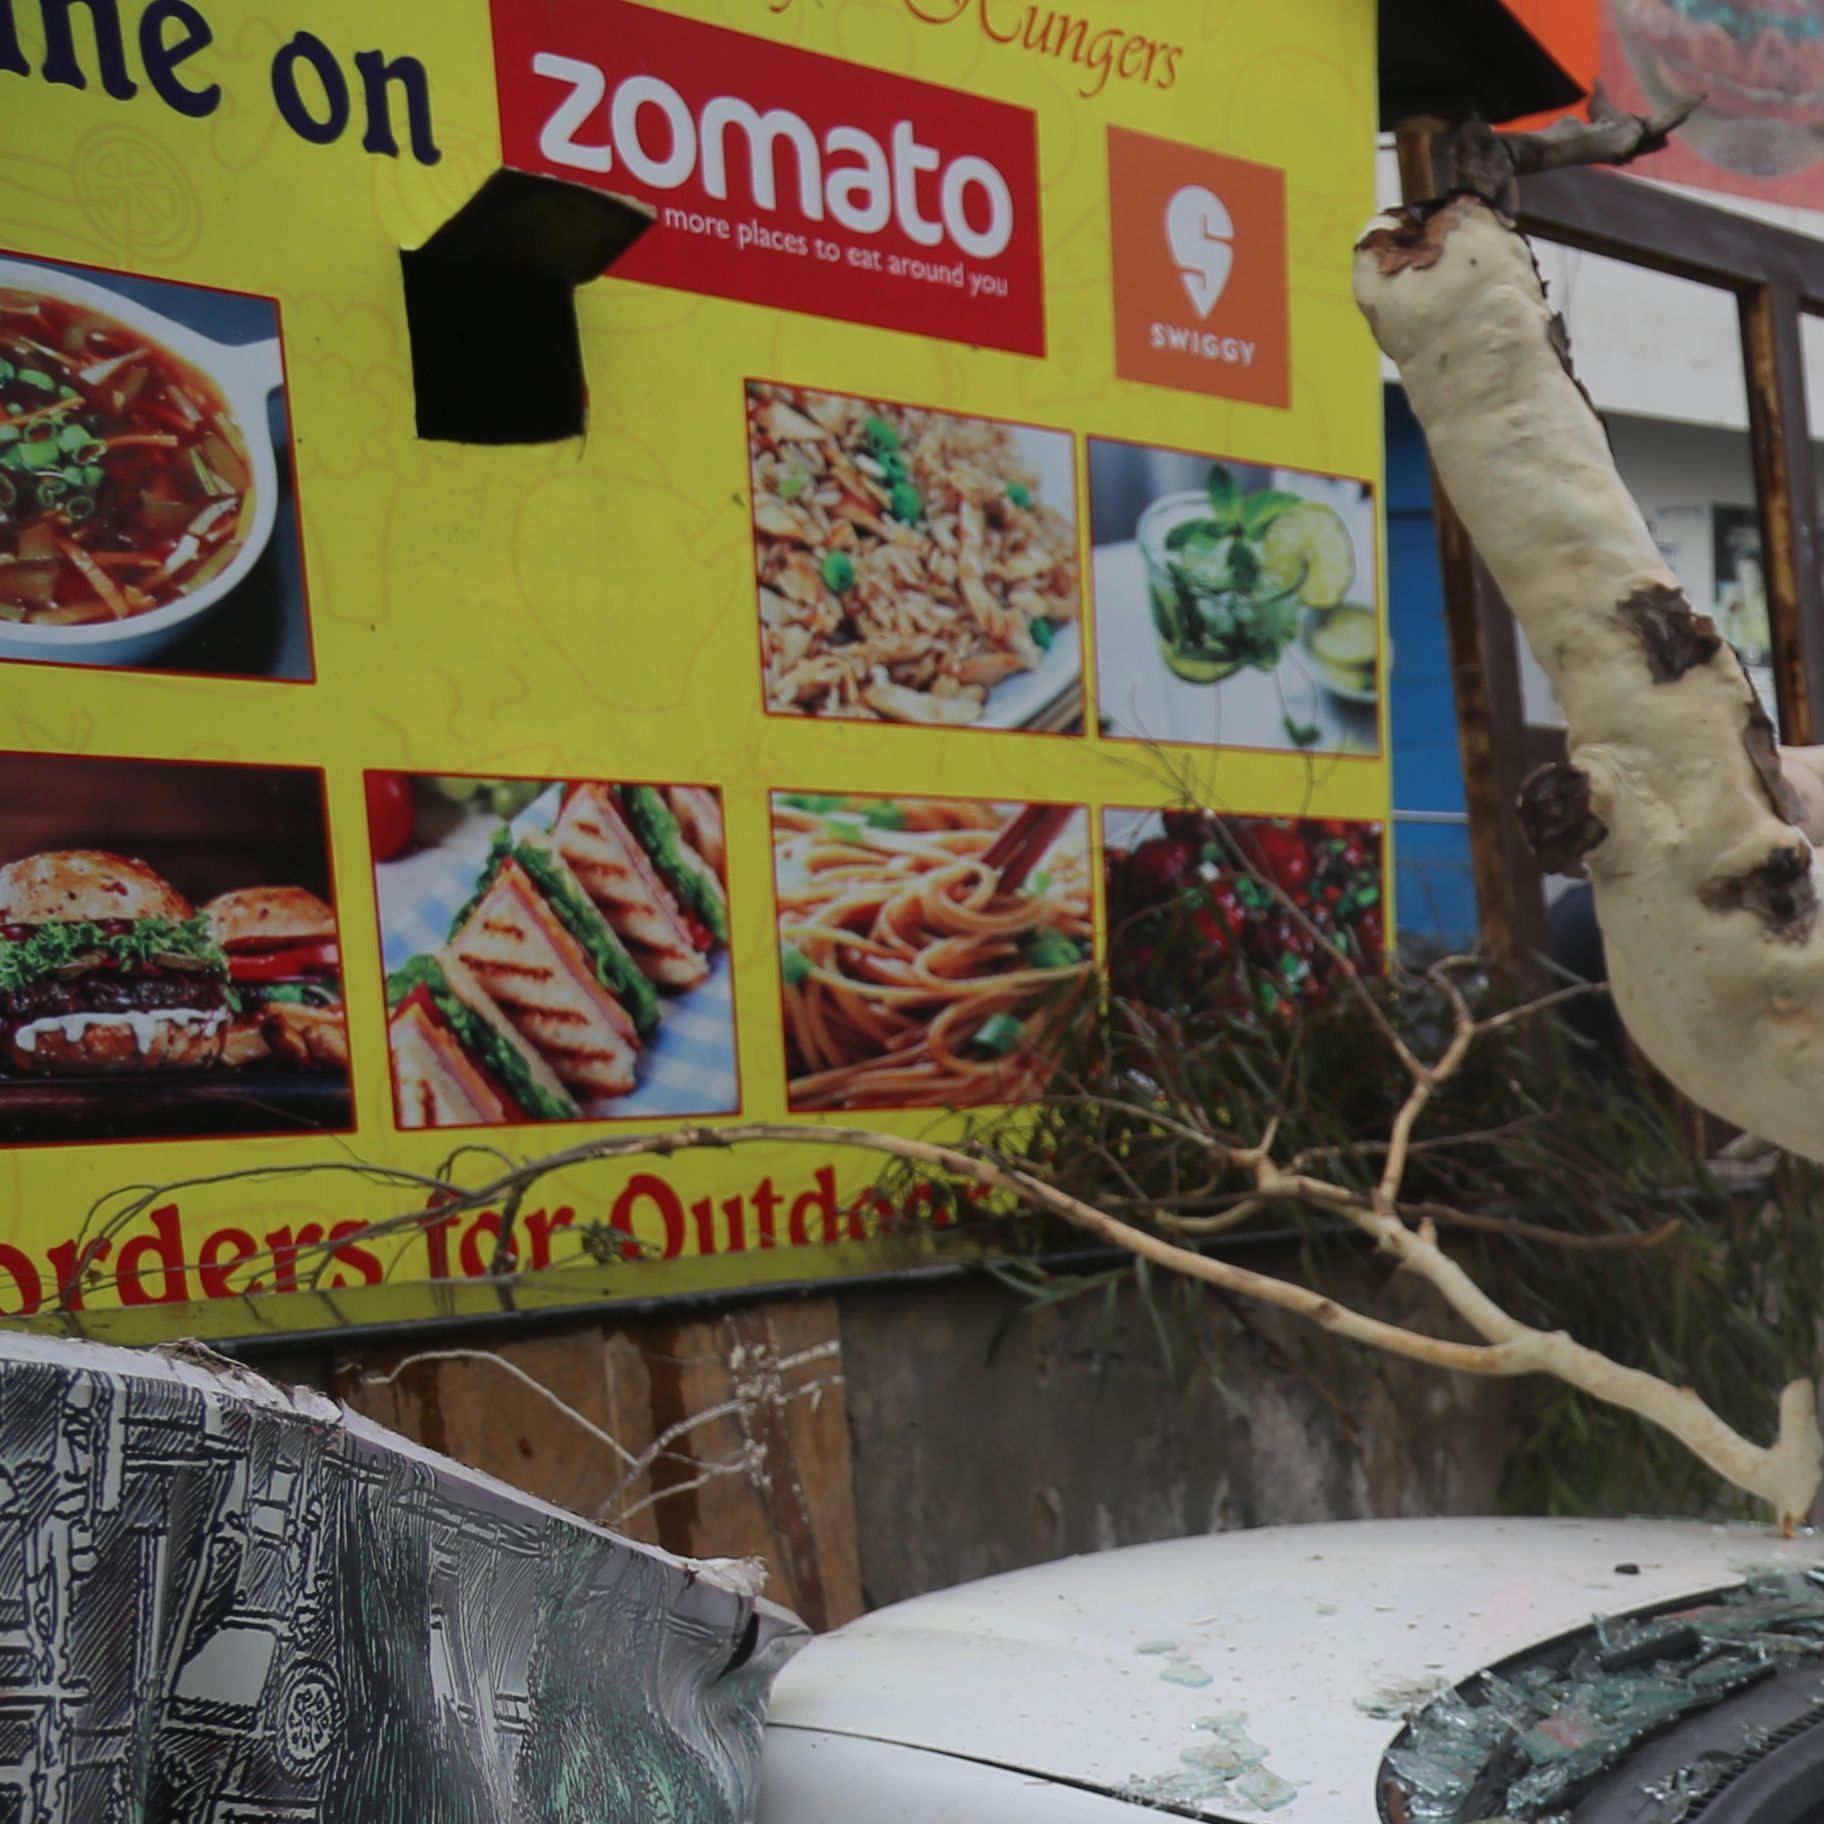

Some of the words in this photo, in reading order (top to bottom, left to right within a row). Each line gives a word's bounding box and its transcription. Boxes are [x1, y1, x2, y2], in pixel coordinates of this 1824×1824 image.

[271, 30, 442, 166] on
[532, 51, 1014, 259] zomato
[664, 206, 731, 240] more
[737, 219, 808, 250] places
[815, 234, 841, 263] to
[846, 245, 882, 272] eat
[887, 255, 965, 289] around
[969, 270, 1009, 298] you
[1149, 321, 1256, 366] SWIGGY
[417, 1188, 576, 1282] for
